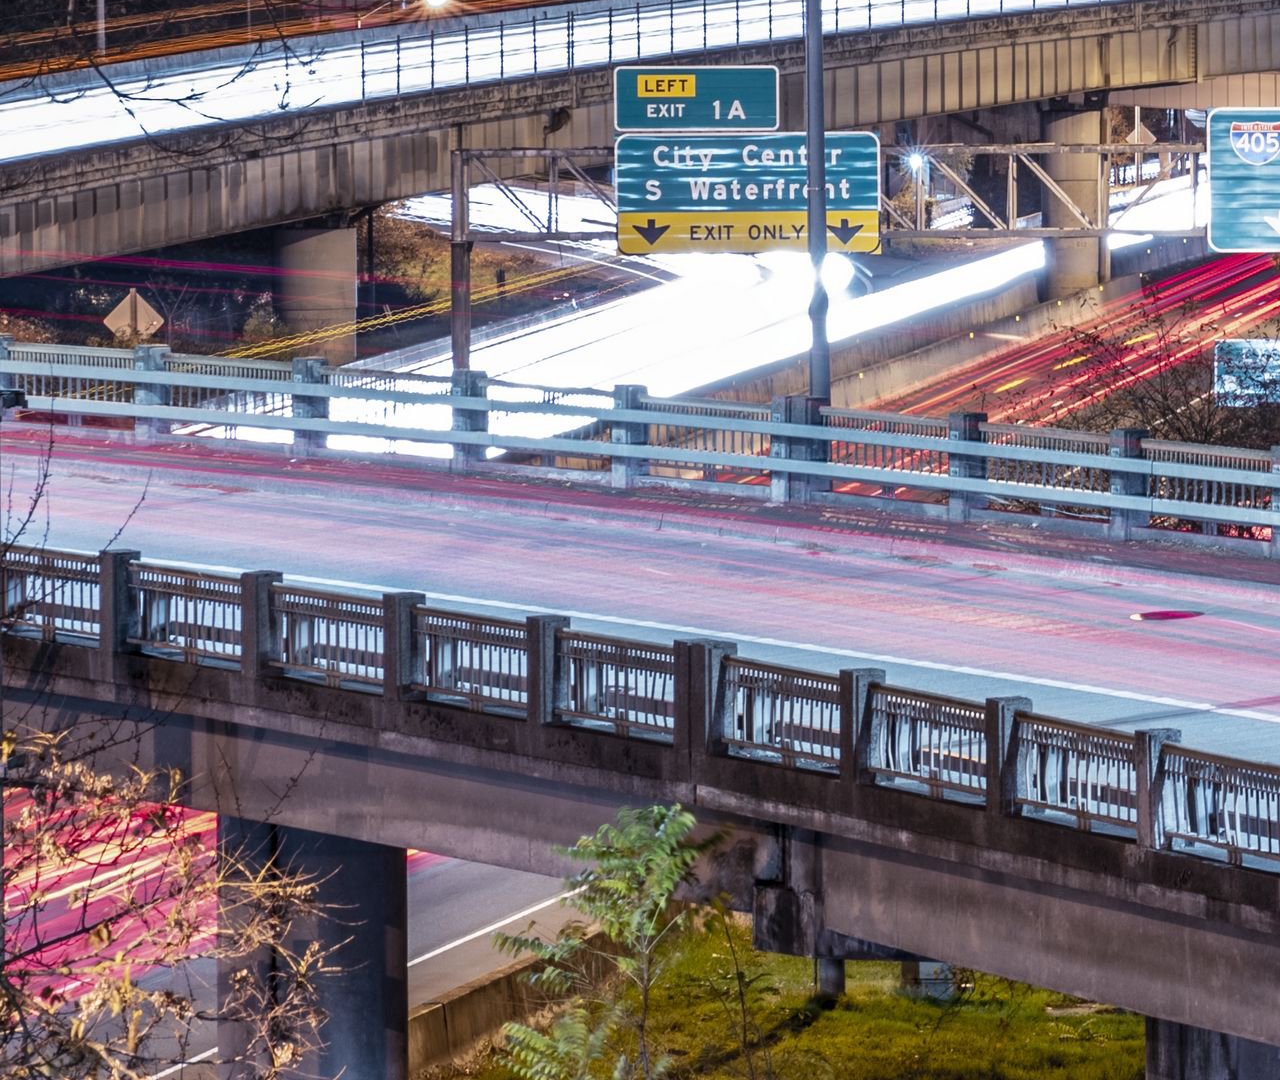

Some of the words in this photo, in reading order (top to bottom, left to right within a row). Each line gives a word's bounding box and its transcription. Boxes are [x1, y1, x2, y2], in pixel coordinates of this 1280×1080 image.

[645, 79, 688, 93] LEFT
[647, 104, 686, 117] EXIT
[713, 100, 746, 120] 1A
[1236, 132, 1280, 153] 405
[653, 145, 713, 171] City
[742, 145, 842, 166] Centr
[645, 180, 662, 201] S
[690, 225, 735, 240] EXIT
[748, 224, 805, 240] ONLY
